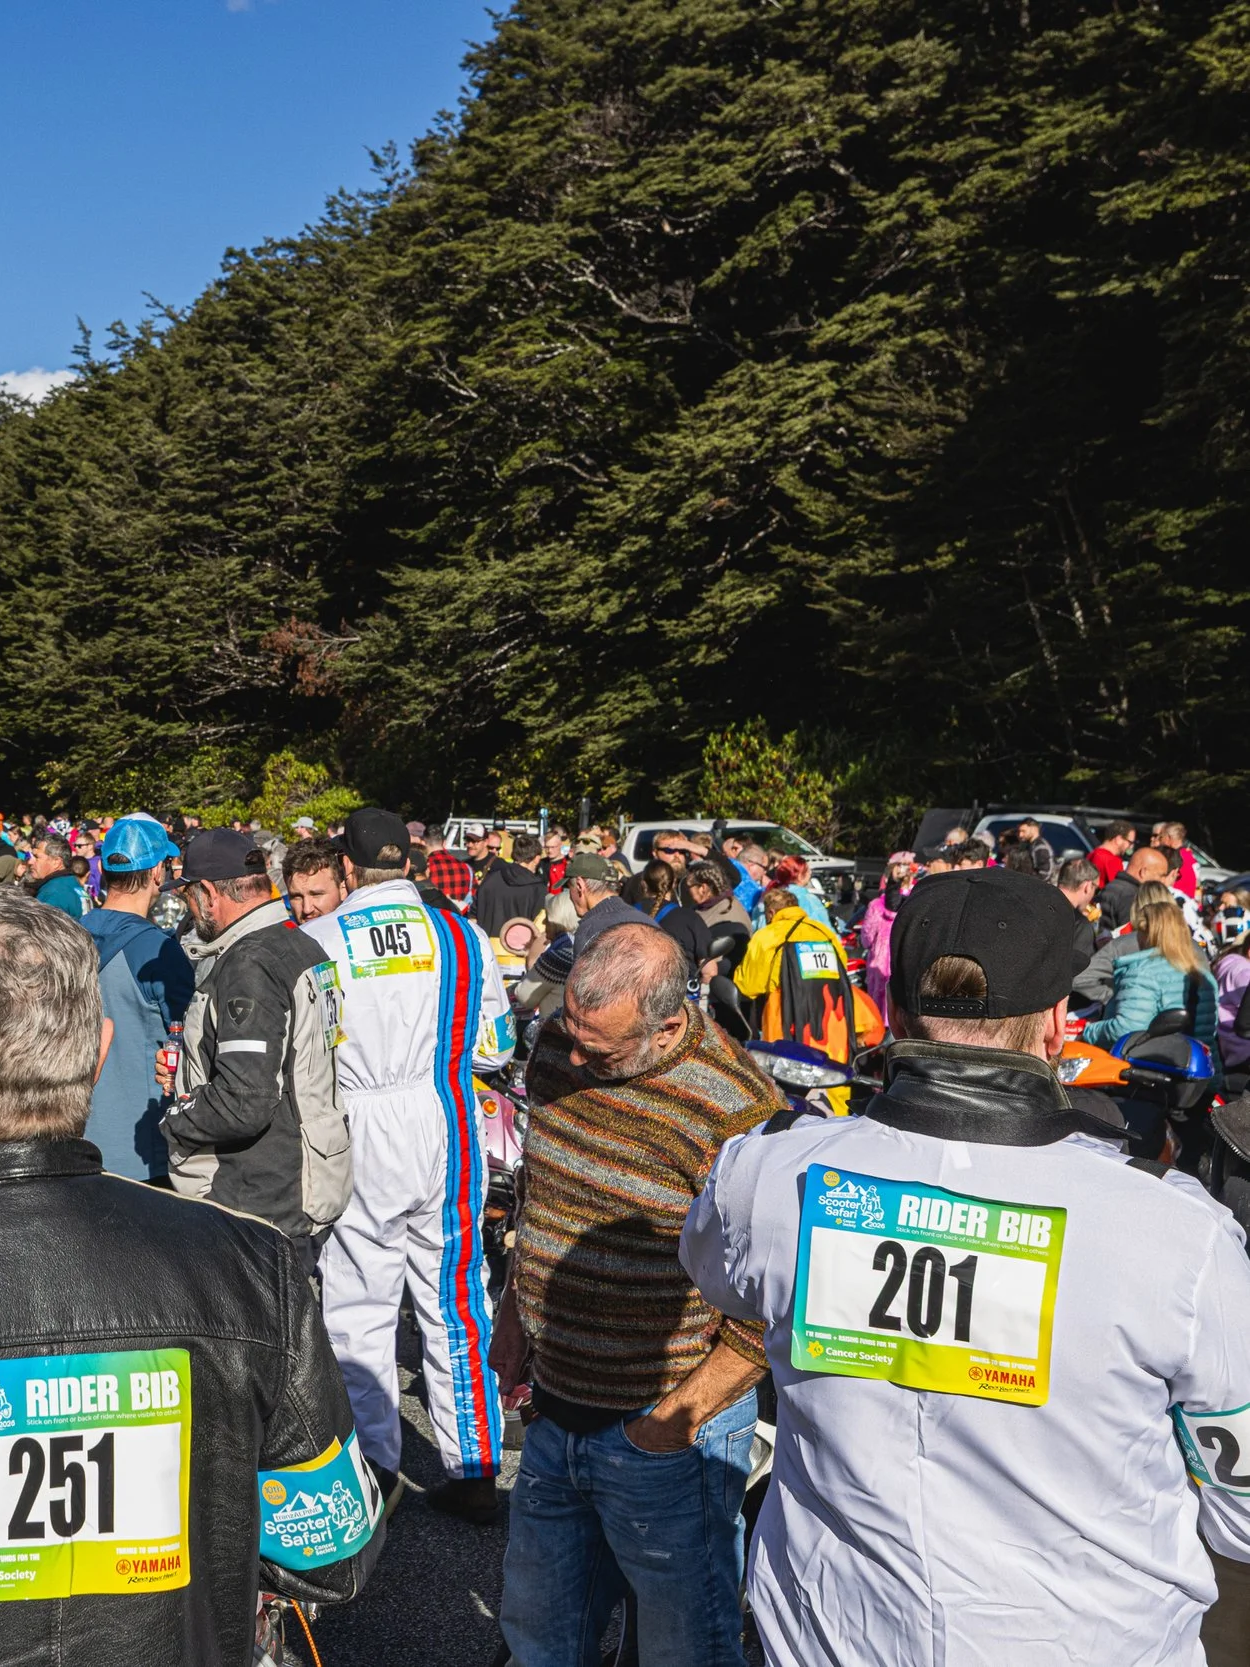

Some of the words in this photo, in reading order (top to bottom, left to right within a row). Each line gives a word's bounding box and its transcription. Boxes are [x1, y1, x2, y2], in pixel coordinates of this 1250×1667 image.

[369, 923, 412, 957] 045
[813, 953, 829, 968] 112
[818, 1195, 862, 1209] Scooter
[825, 1206, 858, 1218] Safari
[869, 1221, 886, 1229] 2026
[897, 1194, 989, 1239] RIDER
[997, 1210, 1053, 1248] BIB
[896, 1226, 910, 1234] Stick
[920, 1230, 936, 1238] front
[943, 1233, 959, 1241] back
[966, 1236, 981, 1244] rider
[981, 1239, 1001, 1248] where
[868, 1240, 979, 1342] 201
[825, 1346, 858, 1359] Cancer
[858, 1351, 894, 1365] Society
[984, 1368, 1036, 1388] YAMAHA
[25, 1374, 120, 1418] RIDER
[129, 1369, 181, 1411] BIB
[26, 1418, 43, 1426] Stick
[53, 1417, 69, 1425] front
[116, 1412, 137, 1420] where
[137, 1410, 156, 1418] visible
[8, 1432, 115, 1540] 251
[264, 1514, 332, 1535] Scooter
[280, 1526, 333, 1548] Safari
[132, 1555, 181, 1573] YAMAHA
